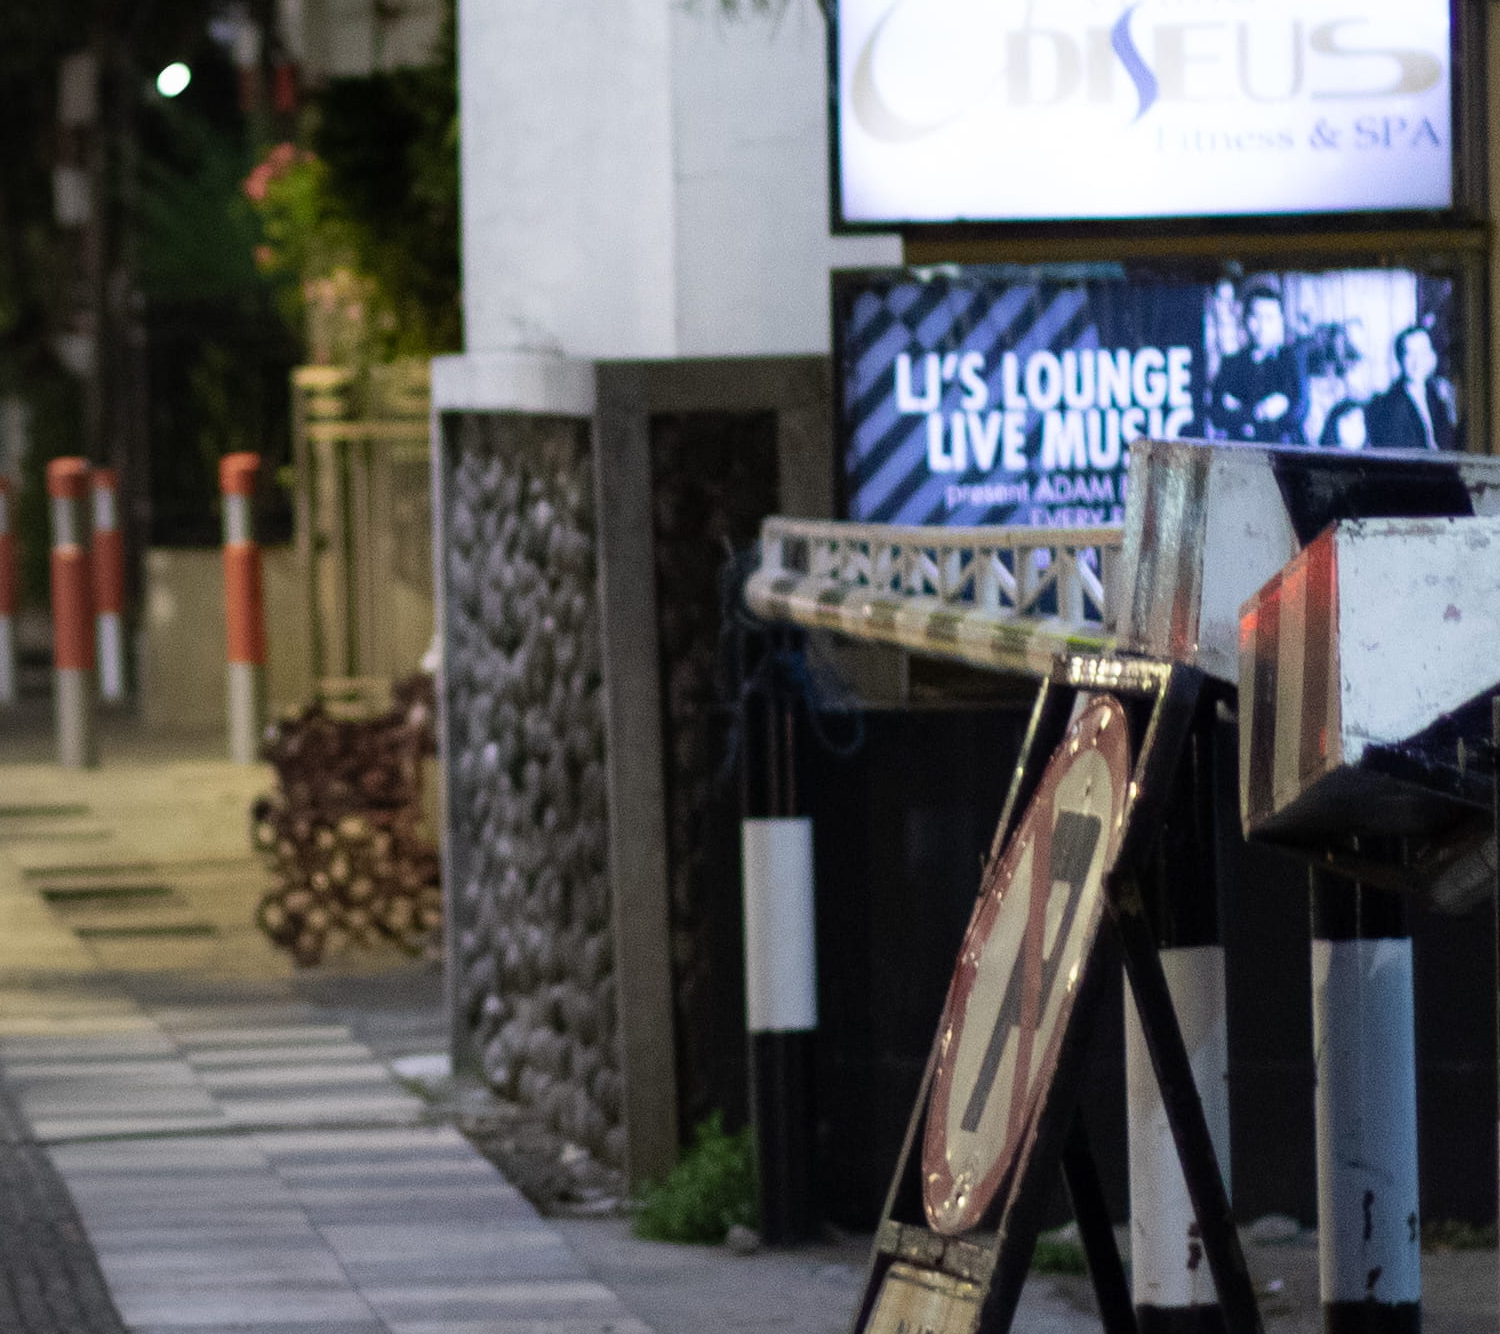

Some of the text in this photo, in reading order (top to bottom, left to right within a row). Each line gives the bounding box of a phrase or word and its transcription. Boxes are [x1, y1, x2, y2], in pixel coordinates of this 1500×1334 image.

[1307, 117, 1343, 154] &
[1352, 114, 1442, 152] SPA
[893, 344, 1195, 415] LJ'S LOUNGE
[926, 408, 1029, 473] LIVE
[1033, 472, 1116, 503] ADAM
